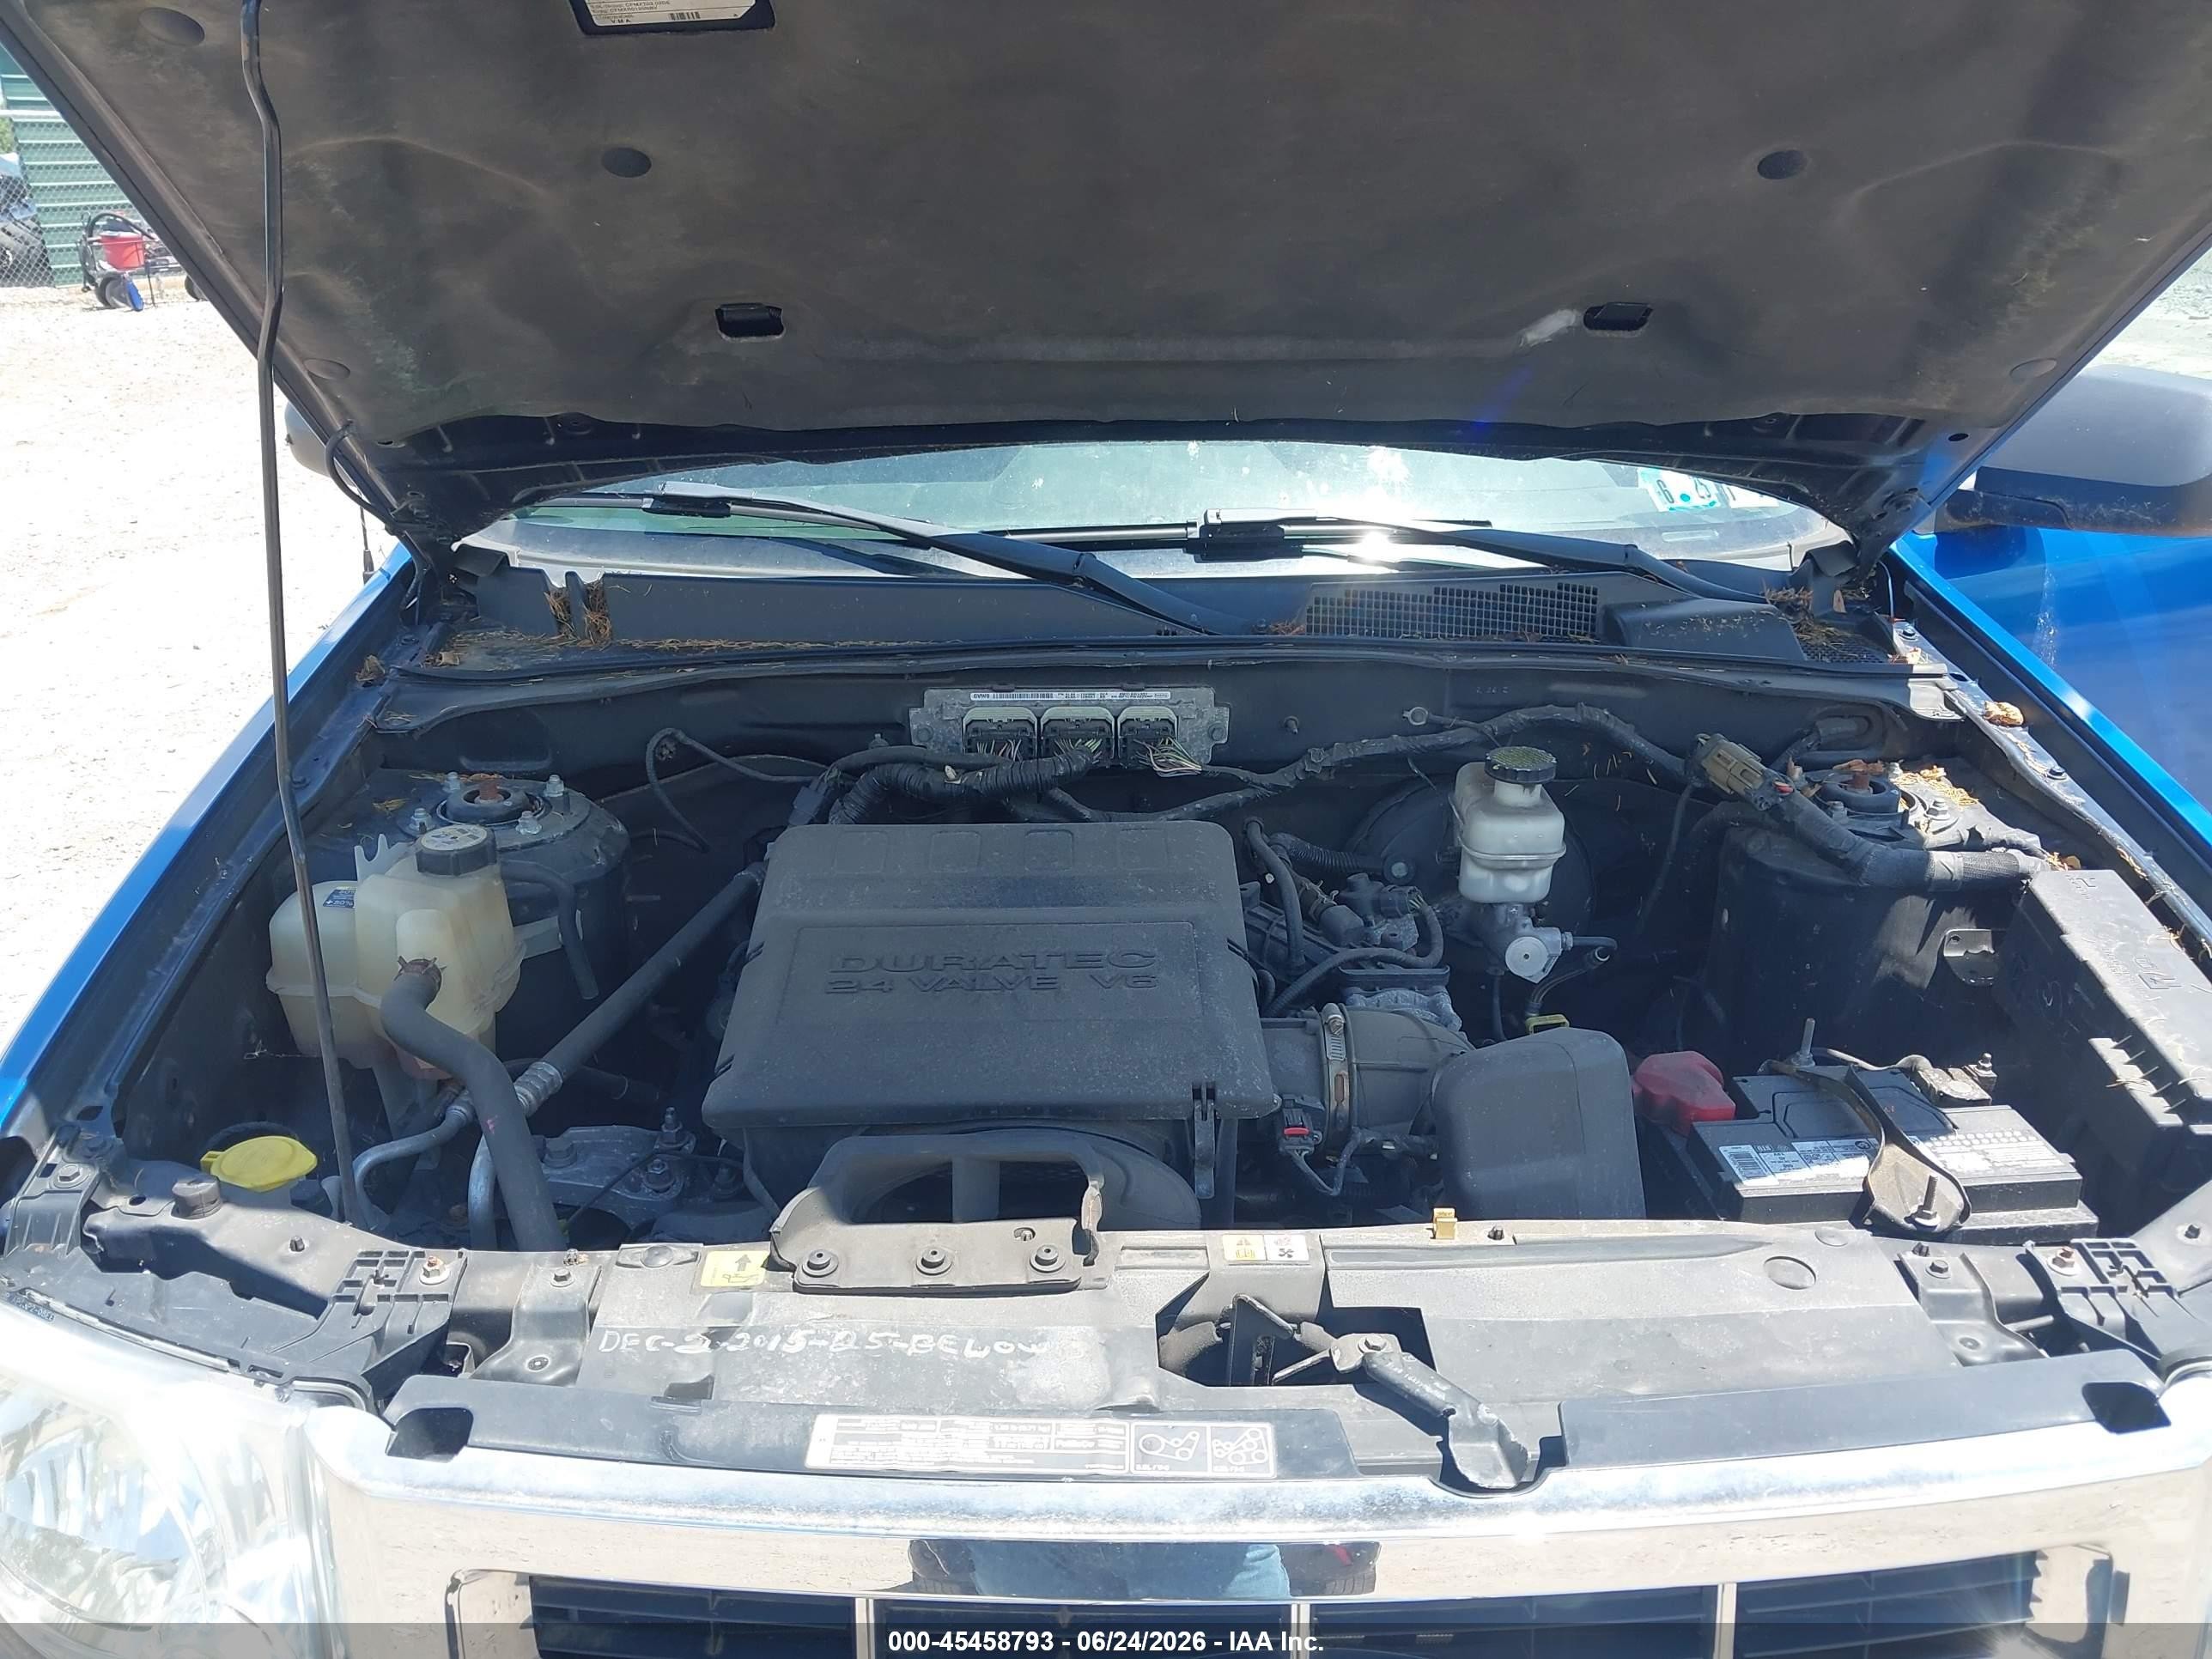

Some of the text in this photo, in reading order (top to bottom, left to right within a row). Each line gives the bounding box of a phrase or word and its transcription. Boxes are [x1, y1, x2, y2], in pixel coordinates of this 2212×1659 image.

[1656, 479, 1674, 504] 6
[829, 950, 1157, 974] DURATEC
[824, 974, 1159, 994] 24 VALVE V6
